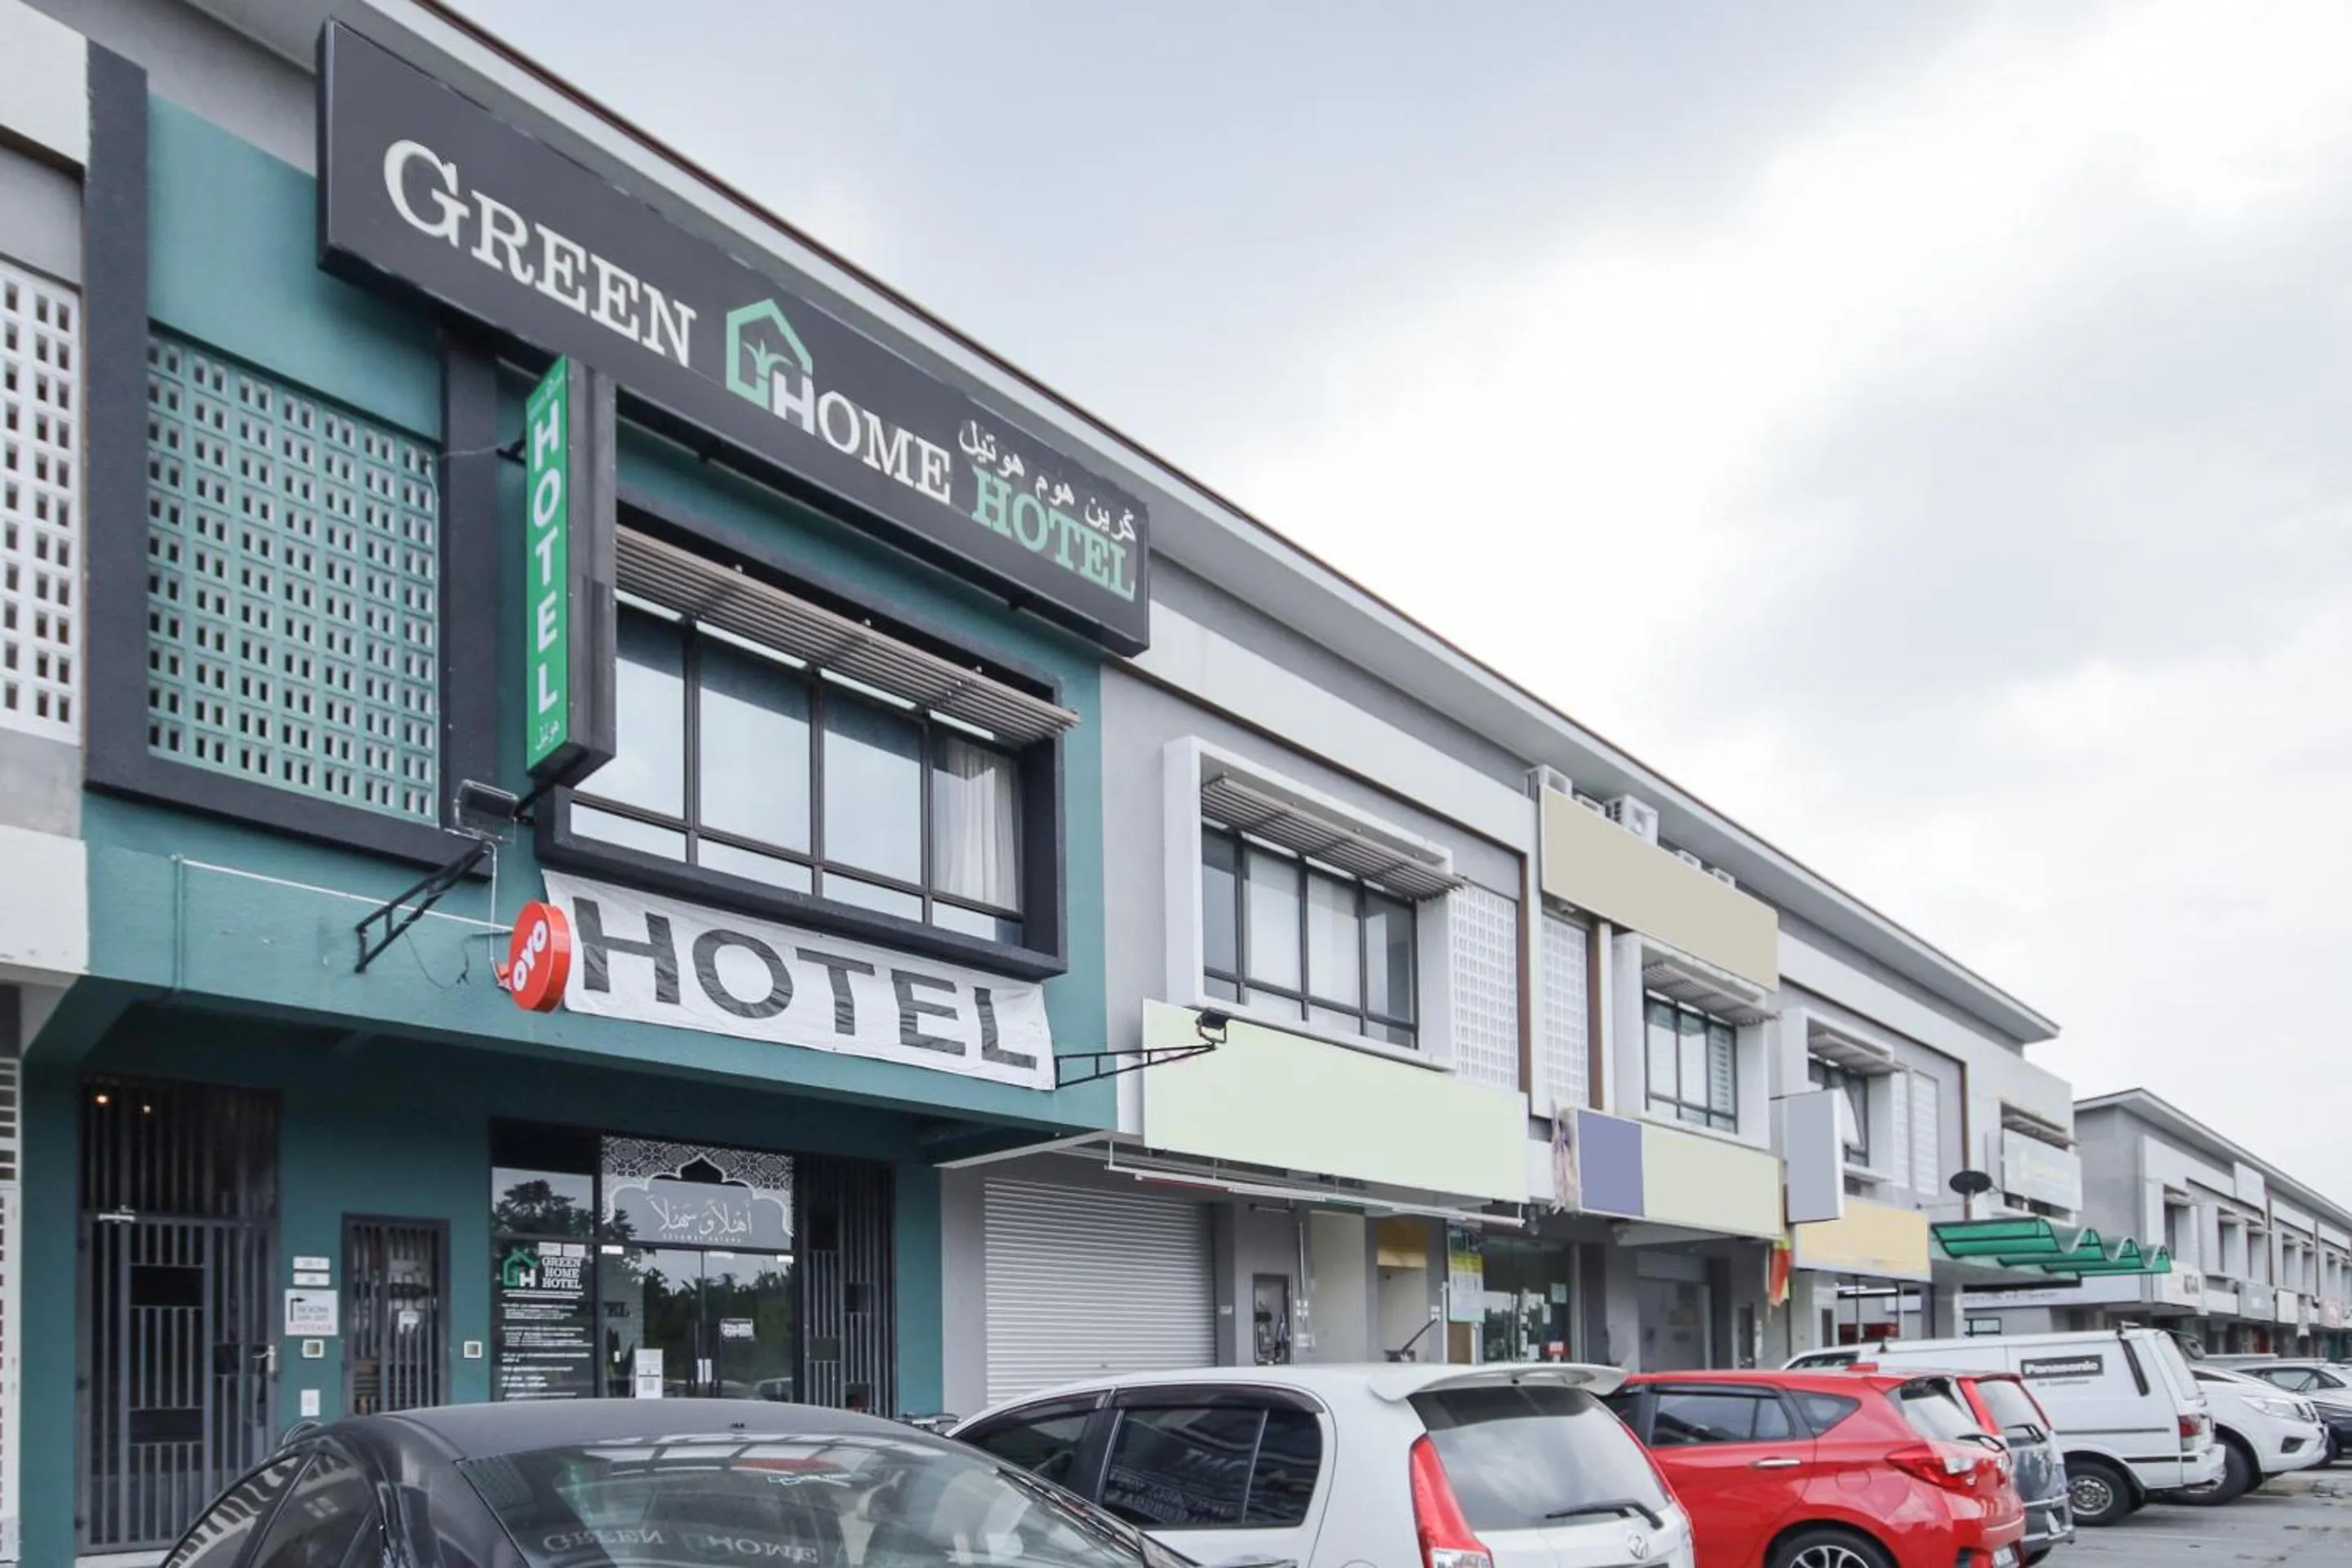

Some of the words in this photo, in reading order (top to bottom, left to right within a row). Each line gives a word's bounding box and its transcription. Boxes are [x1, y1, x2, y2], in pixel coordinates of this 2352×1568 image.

[384, 140, 697, 368] GREEN
[773, 370, 951, 506] HOME
[533, 399, 562, 715] HOTEL
[971, 465, 1136, 603] HOTEL
[513, 920, 548, 993] OYO
[572, 896, 1037, 1071] HOTEL
[541, 1256, 581, 1268] GREEN
[542, 1277, 583, 1290] HOTEL
[545, 1267, 580, 1279] HOME
[2025, 1360, 2100, 1374] Panasonic
